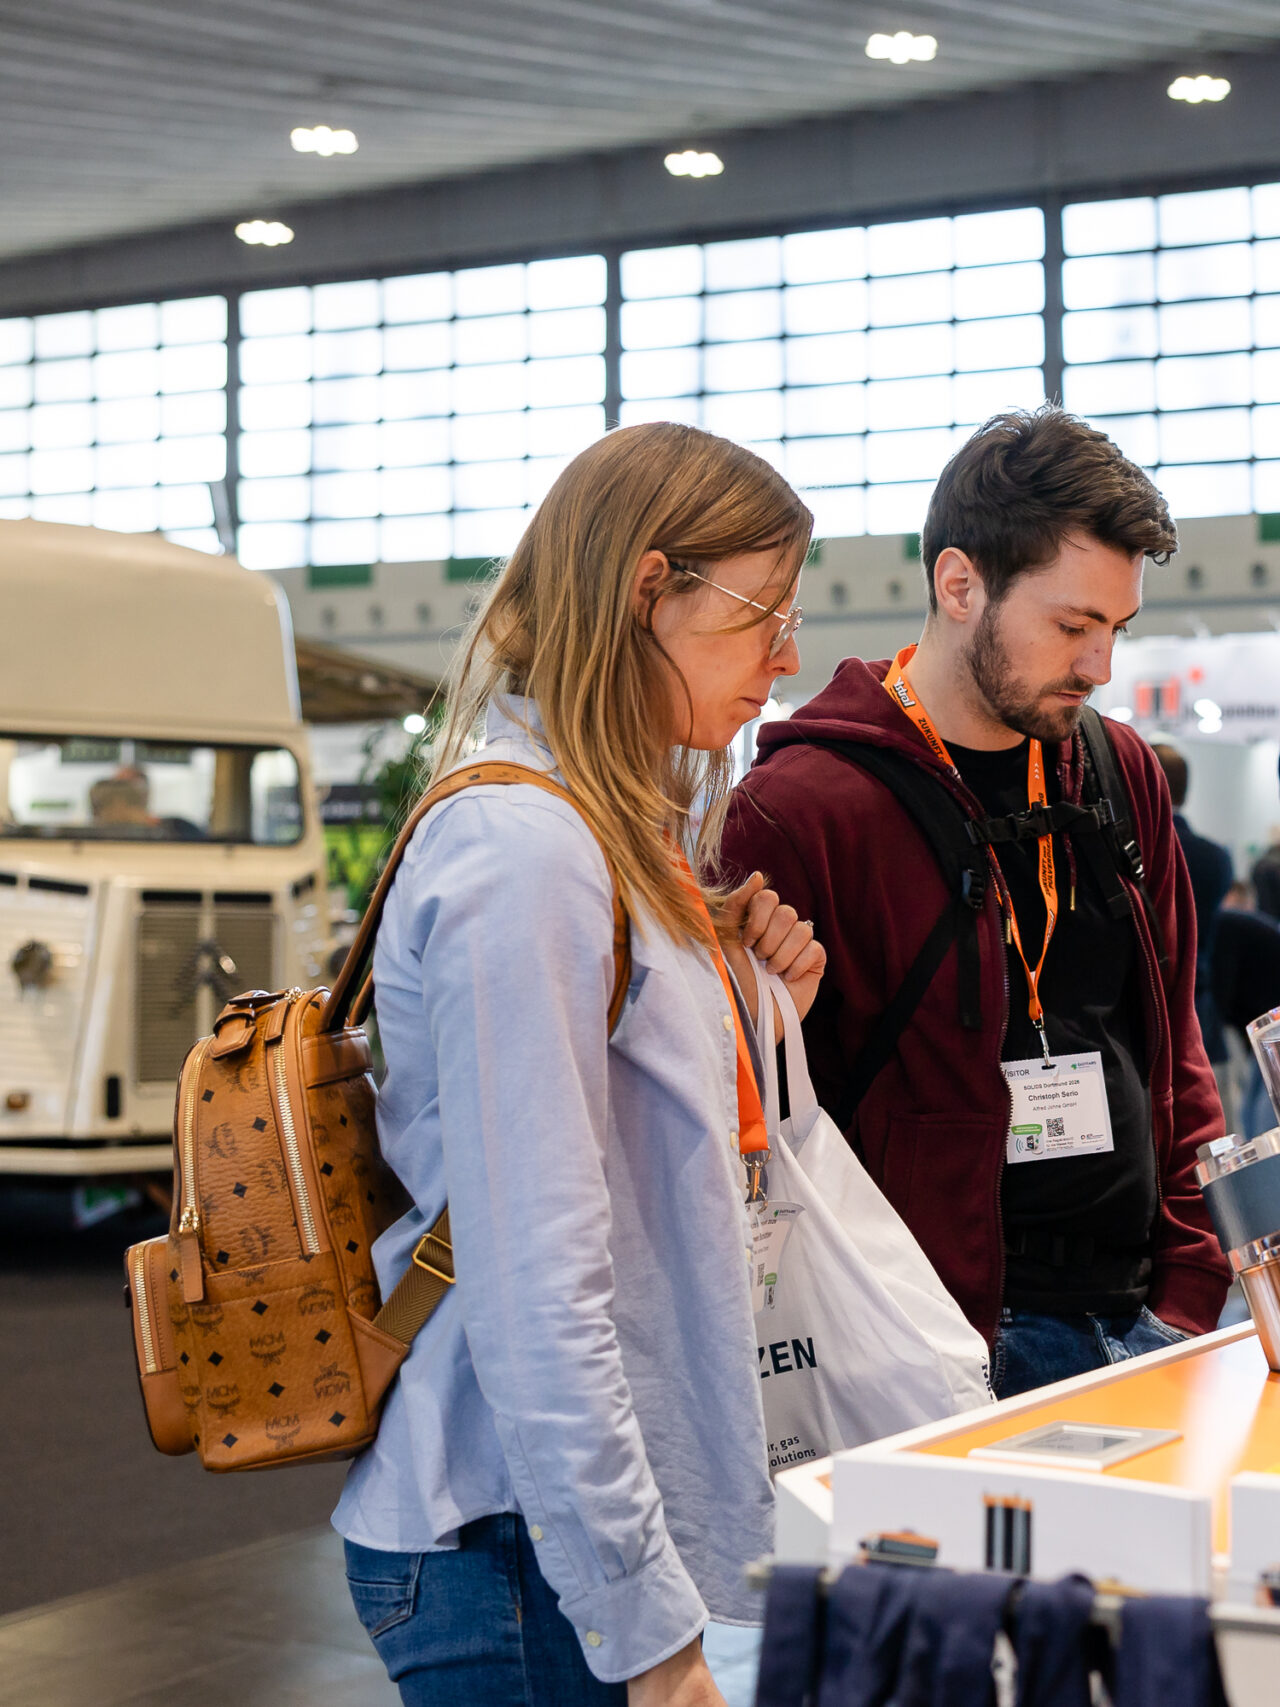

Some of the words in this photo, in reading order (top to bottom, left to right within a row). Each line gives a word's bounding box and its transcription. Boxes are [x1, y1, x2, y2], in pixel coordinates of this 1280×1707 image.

[918, 717, 944, 758] ZUKUNFT
[1028, 1094, 1060, 1102] Christoph
[780, 1435, 800, 1450] gas
[768, 1448, 817, 1468] olutions
